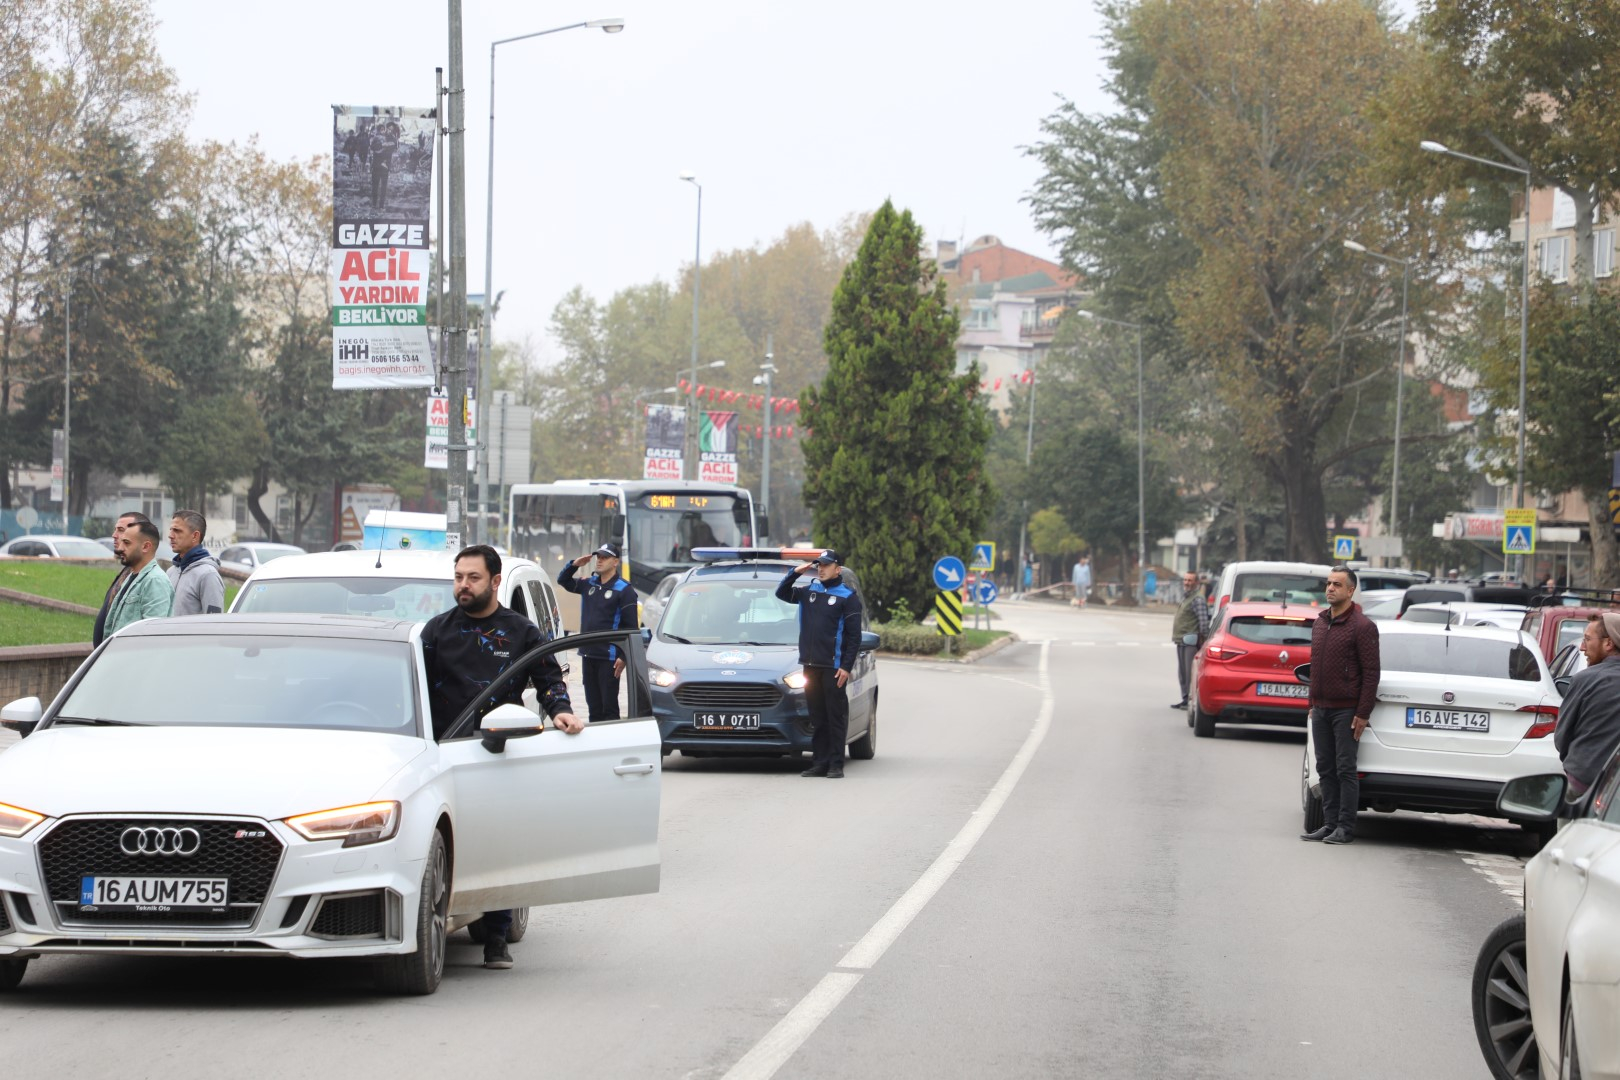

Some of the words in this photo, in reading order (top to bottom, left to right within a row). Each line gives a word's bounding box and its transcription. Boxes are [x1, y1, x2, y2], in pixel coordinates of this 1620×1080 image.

[339, 223, 424, 246] GAZZE
[339, 286, 419, 304] YARDIM
[371, 355, 387, 363] 0506
[388, 355, 400, 363] 156
[646, 448, 681, 458] GAZZE
[701, 452, 736, 462] GAZZE
[646, 471, 680, 480] YARDIM
[1263, 685, 1273, 693] 16
[1274, 685, 1290, 694] ALK
[701, 714, 714, 726] 16
[719, 714, 726, 726] Y
[731, 715, 757, 726] 0711
[1416, 710, 1432, 724] 16
[1434, 712, 1460, 725] AVE
[1463, 713, 1487, 727] 142
[97, 879, 121, 903] 16
[123, 880, 179, 903] AUM
[181, 880, 226, 903] 755
